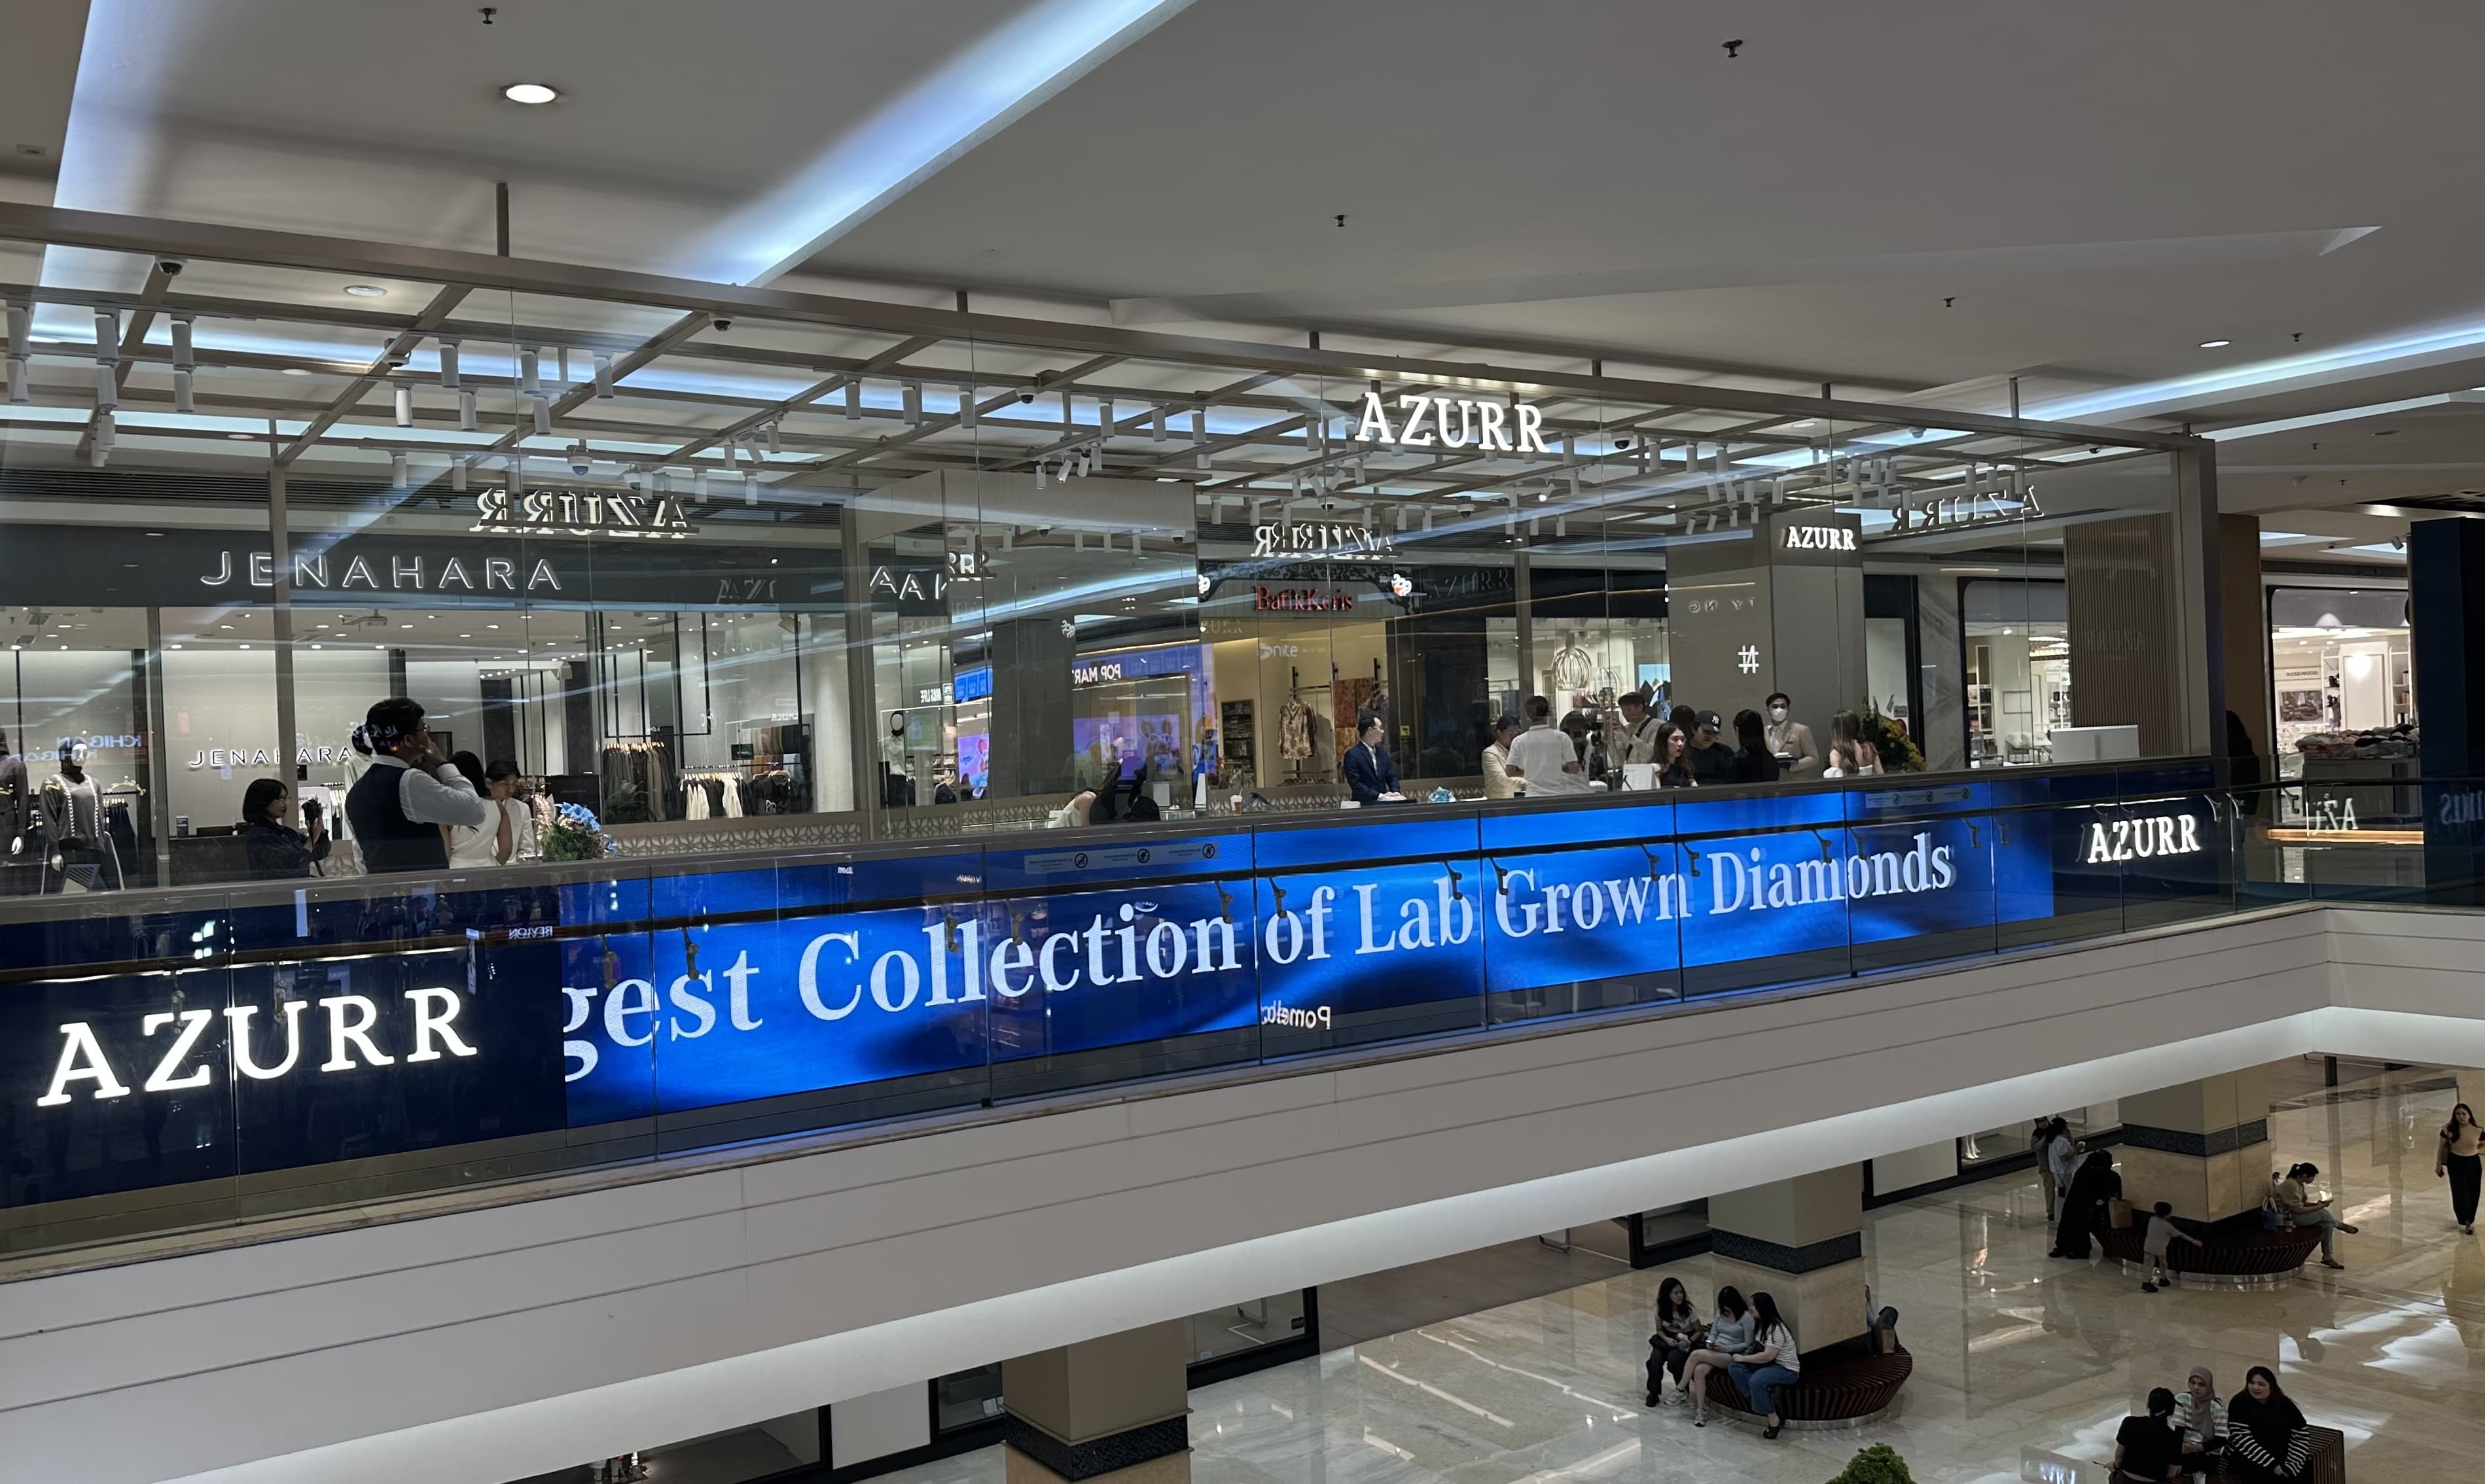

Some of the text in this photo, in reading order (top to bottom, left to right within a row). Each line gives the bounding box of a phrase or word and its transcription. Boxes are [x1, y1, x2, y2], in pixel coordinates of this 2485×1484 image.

[1354, 391, 1550, 453] AZURR
[1785, 525, 1857, 551] AZURR
[200, 550, 562, 590] JENAHARA
[2086, 814, 2200, 864] AZURR
[798, 902, 1242, 1021] Collection
[1264, 885, 1335, 964] of
[1353, 877, 1473, 955] Lab
[1495, 868, 1692, 938] Grown
[1706, 832, 1951, 915] Diamonds
[37, 987, 477, 1107] AZURR
